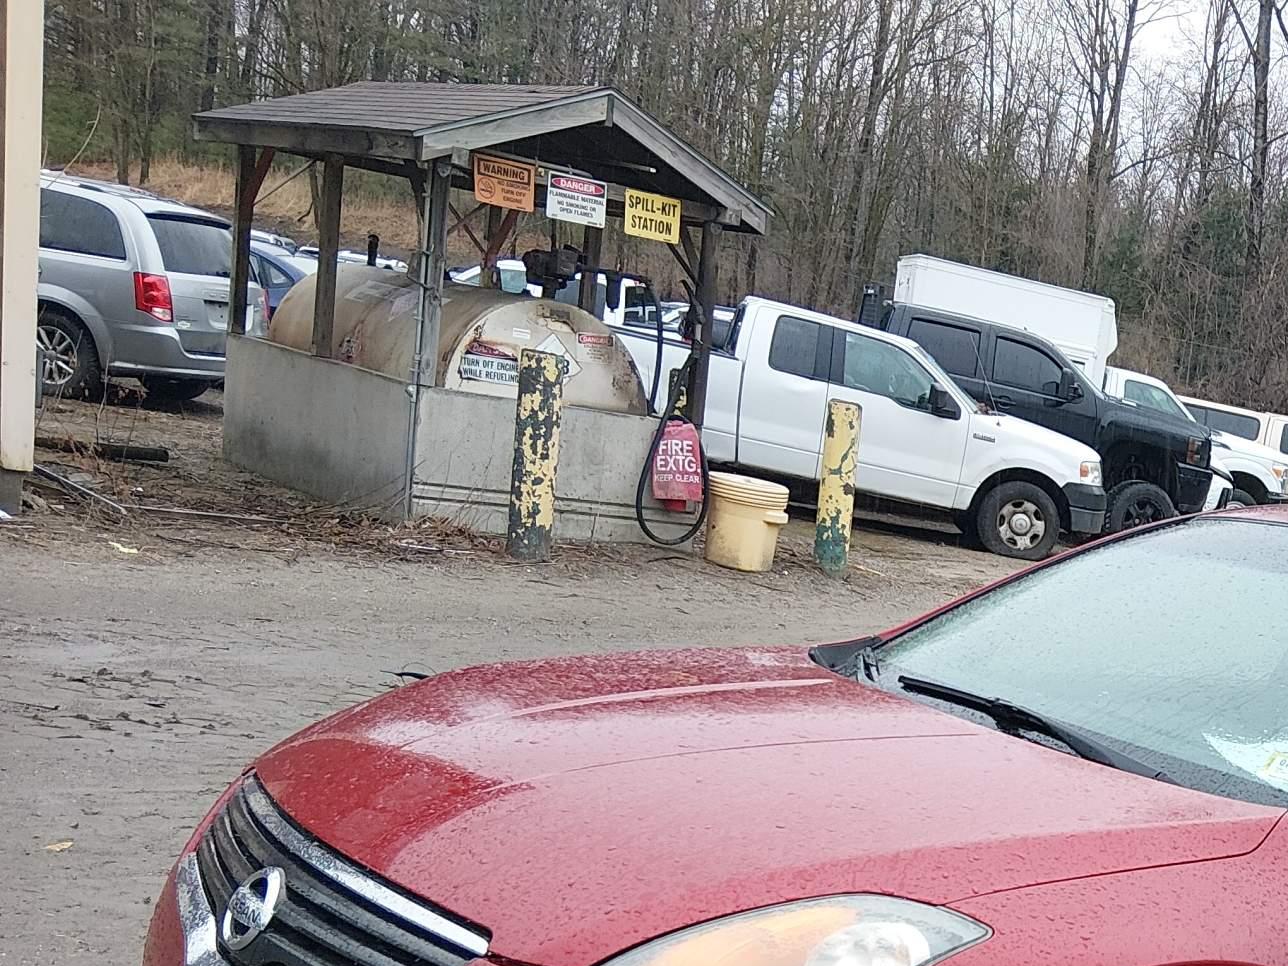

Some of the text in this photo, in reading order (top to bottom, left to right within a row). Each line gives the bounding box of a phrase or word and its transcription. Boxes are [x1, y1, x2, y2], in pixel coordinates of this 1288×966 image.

[483, 162, 525, 180] WARNING
[560, 179, 595, 194] DANGER
[549, 190, 604, 206] FLAMMABLE MATERIAL
[628, 194, 678, 218] SPILL-KIT
[566, 202, 588, 211] SMOKING
[574, 210, 594, 218] FLAMES
[631, 214, 673, 236] STATION
[463, 368, 482, 378] WHILE
[464, 357, 519, 373] TURN OFF ENGINE
[659, 439, 693, 456] FIRE
[657, 456, 701, 473] EXTG.
[655, 473, 700, 484] KEEP CLEAR
